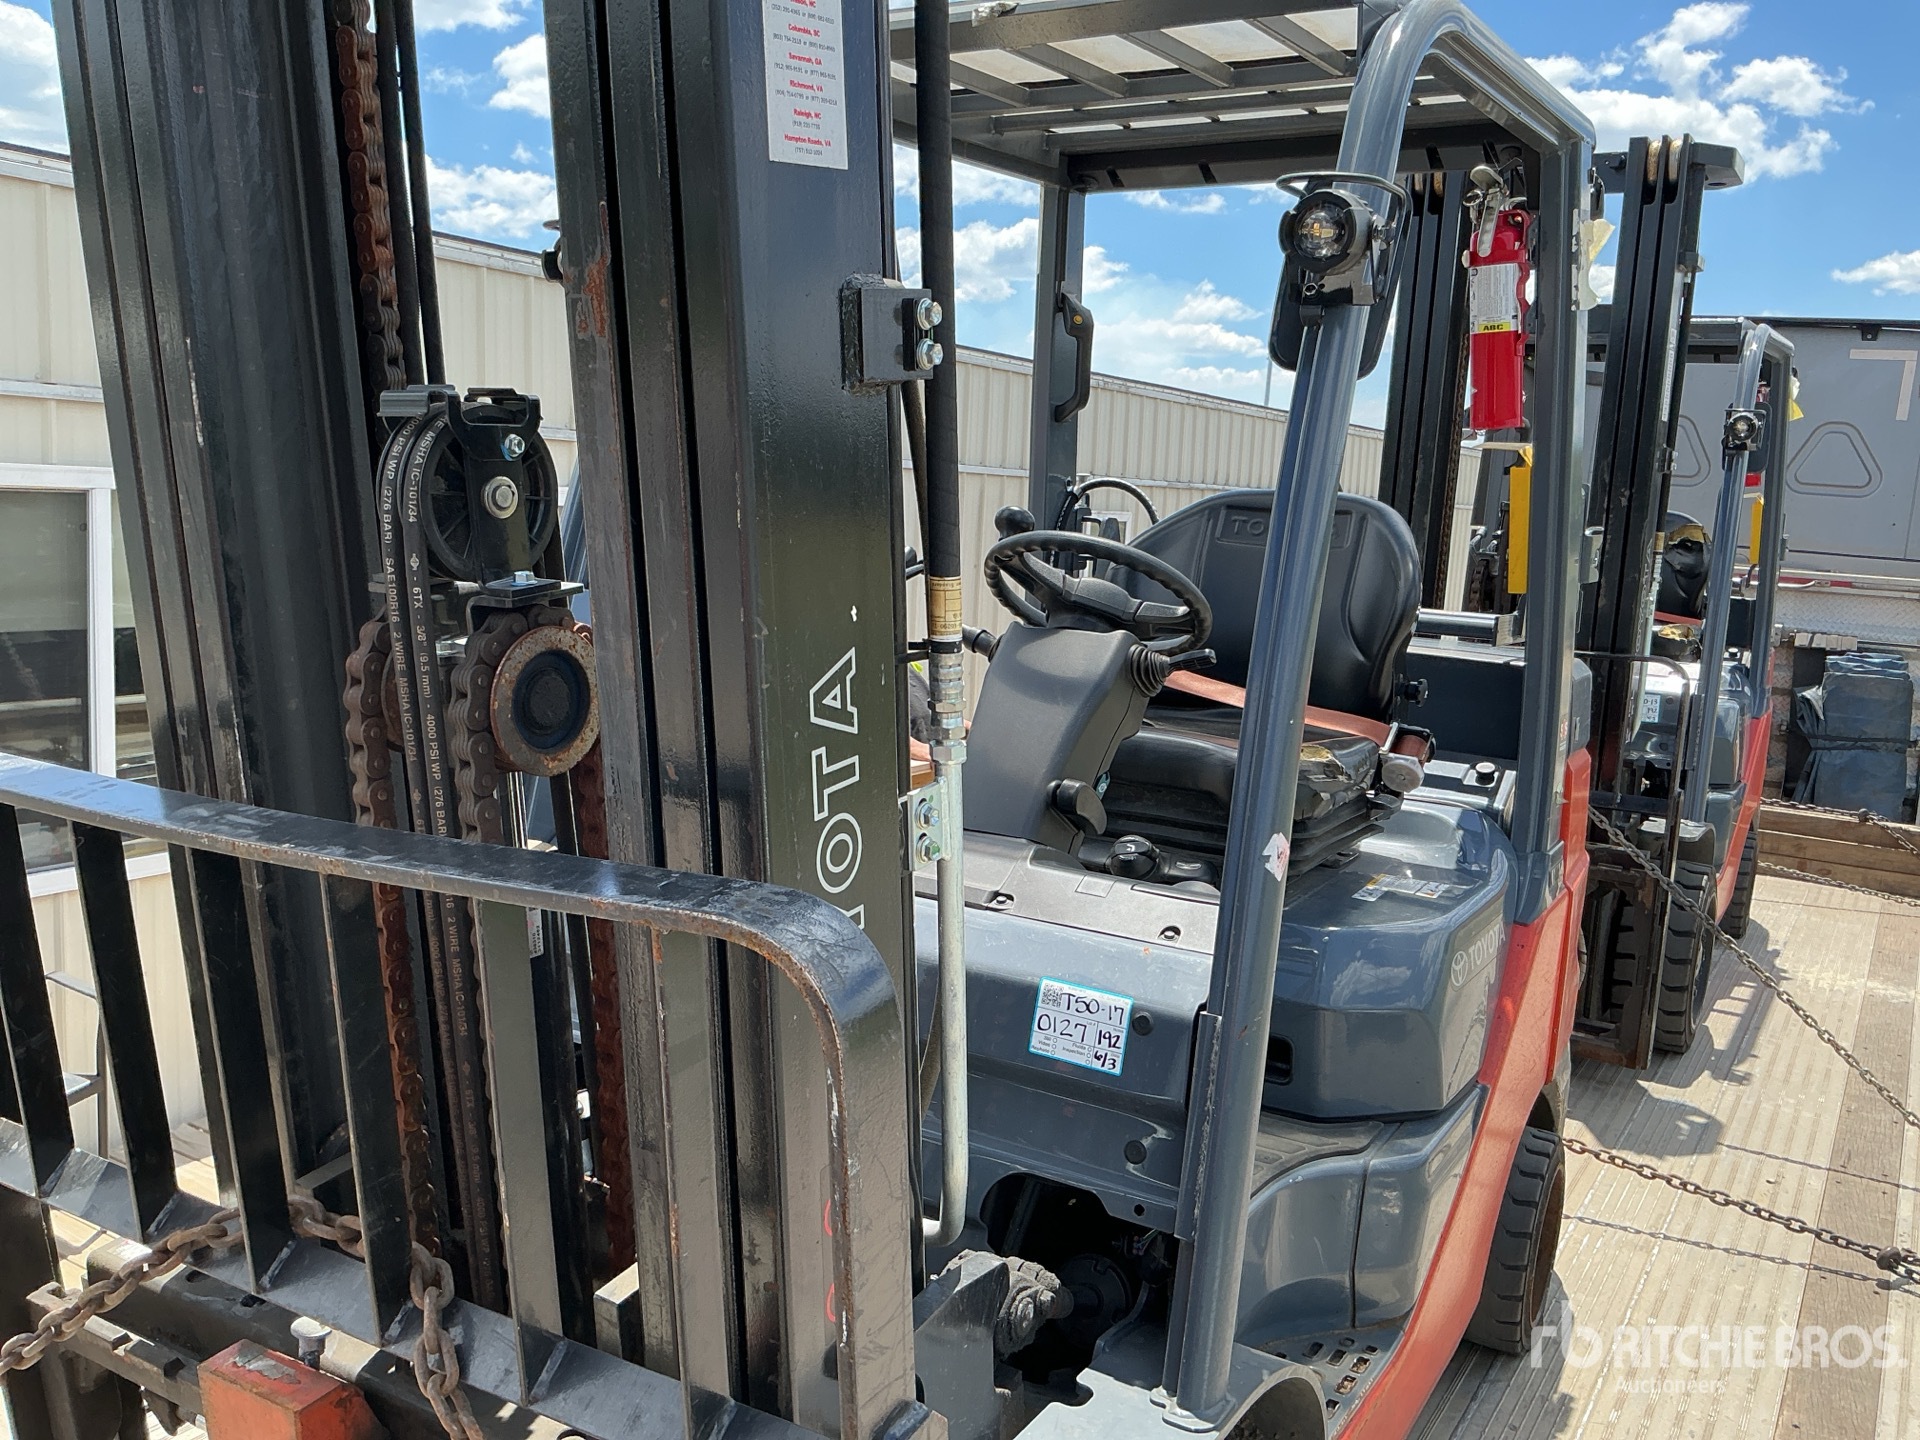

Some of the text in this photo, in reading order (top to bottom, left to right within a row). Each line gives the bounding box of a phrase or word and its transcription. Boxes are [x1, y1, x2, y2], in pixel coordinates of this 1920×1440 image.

[788, 52, 822, 66] Savannah, GA
[789, 79, 823, 93] Richmond, VA
[793, 108, 813, 119] Raleigh,
[784, 133, 807, 144] Hampton
[825, 139, 831, 147] VA
[1482, 323, 1504, 332] ABC
[391, 437, 406, 457] PSI
[414, 431, 436, 465] MSHA
[387, 460, 398, 480] WP
[383, 486, 393, 511] (276
[408, 468, 421, 523] IC-101/34
[383, 514, 393, 544] BAR)
[385, 557, 400, 623] SAE100R16
[412, 586, 424, 609] 6TX
[394, 641, 407, 672] WIRE
[420, 652, 430, 672] (9.5
[399, 677, 411, 710] MSHA
[422, 675, 433, 699] mm)
[403, 712, 418, 762] IC-101/34
[426, 713, 437, 739] 4000
[429, 742, 440, 760] PSI
[431, 762, 442, 781] WP
[434, 786, 444, 808] (276
[448, 925, 460, 953] WIRE
[1468, 917, 1506, 970] TOYOTA
[452, 958, 463, 989] MSHA
[1061, 993, 1125, 1026] T50-17
[1037, 1013, 1088, 1044] 0127
[1097, 1029, 1122, 1050] 192
[1062, 1046, 1086, 1057] Inspection
